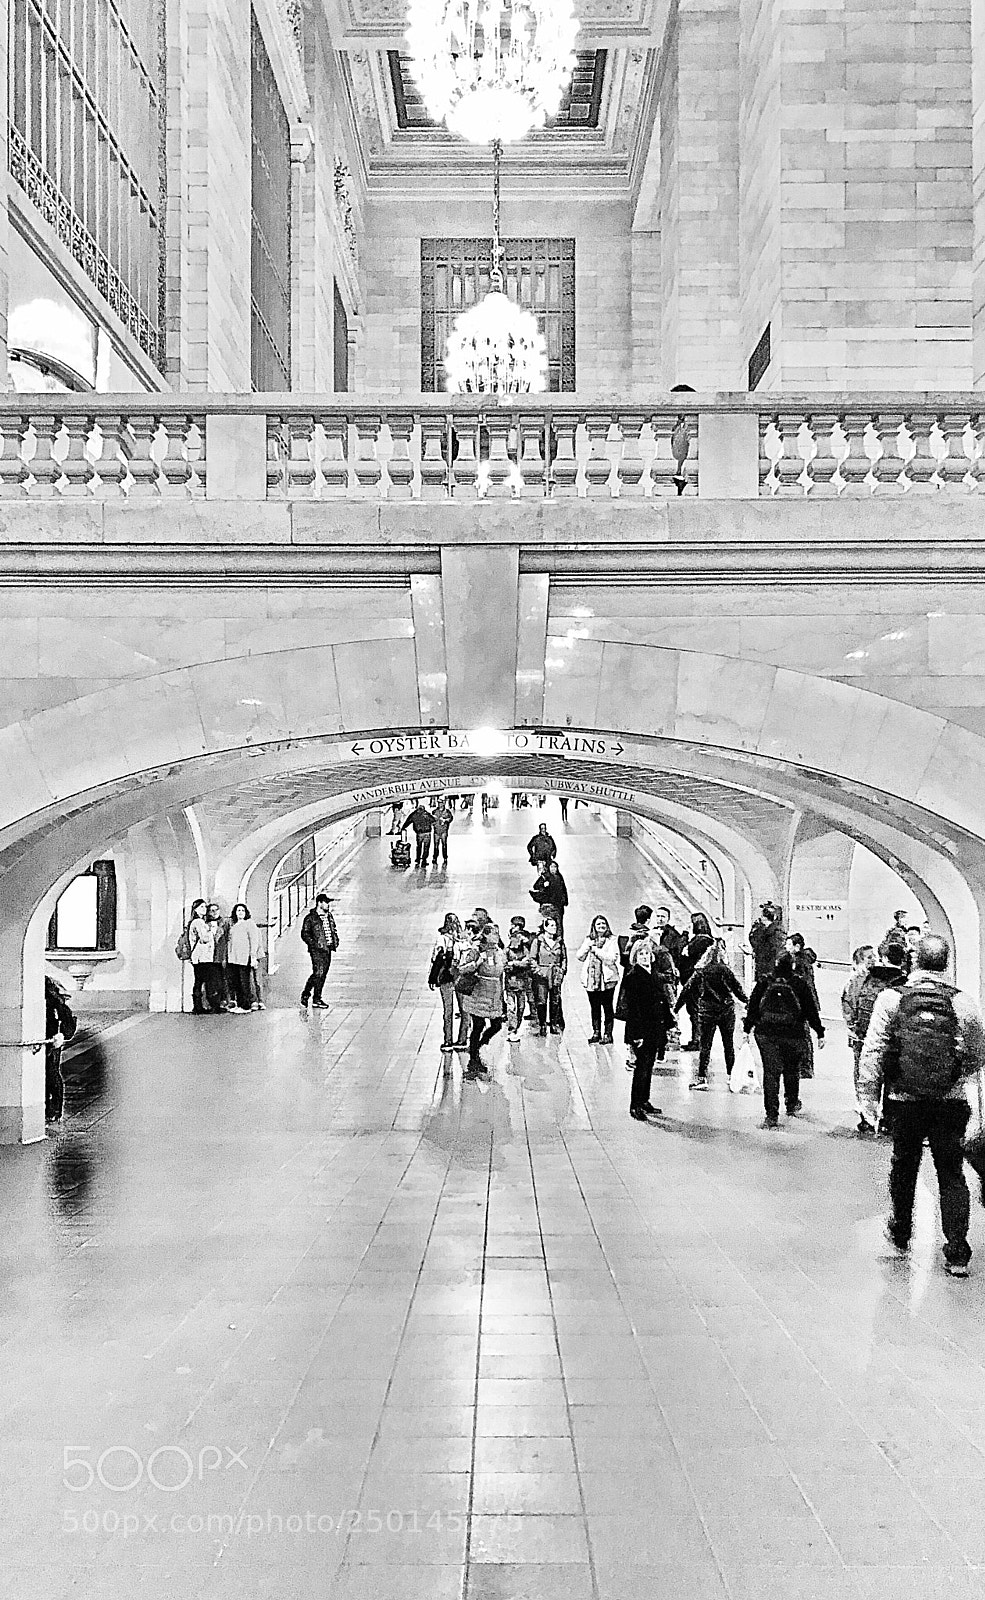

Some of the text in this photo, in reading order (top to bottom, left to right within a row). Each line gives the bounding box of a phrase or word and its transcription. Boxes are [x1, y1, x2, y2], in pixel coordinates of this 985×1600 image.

[369, 736, 441, 754] OYSTER
[506, 734, 528, 748] TO
[536, 736, 606, 754] TRAINS
[352, 782, 417, 802] VANDERBILT
[420, 778, 461, 790] AVENUE
[544, 779, 588, 792] SUBWAY
[589, 785, 636, 802] SHUTTLE
